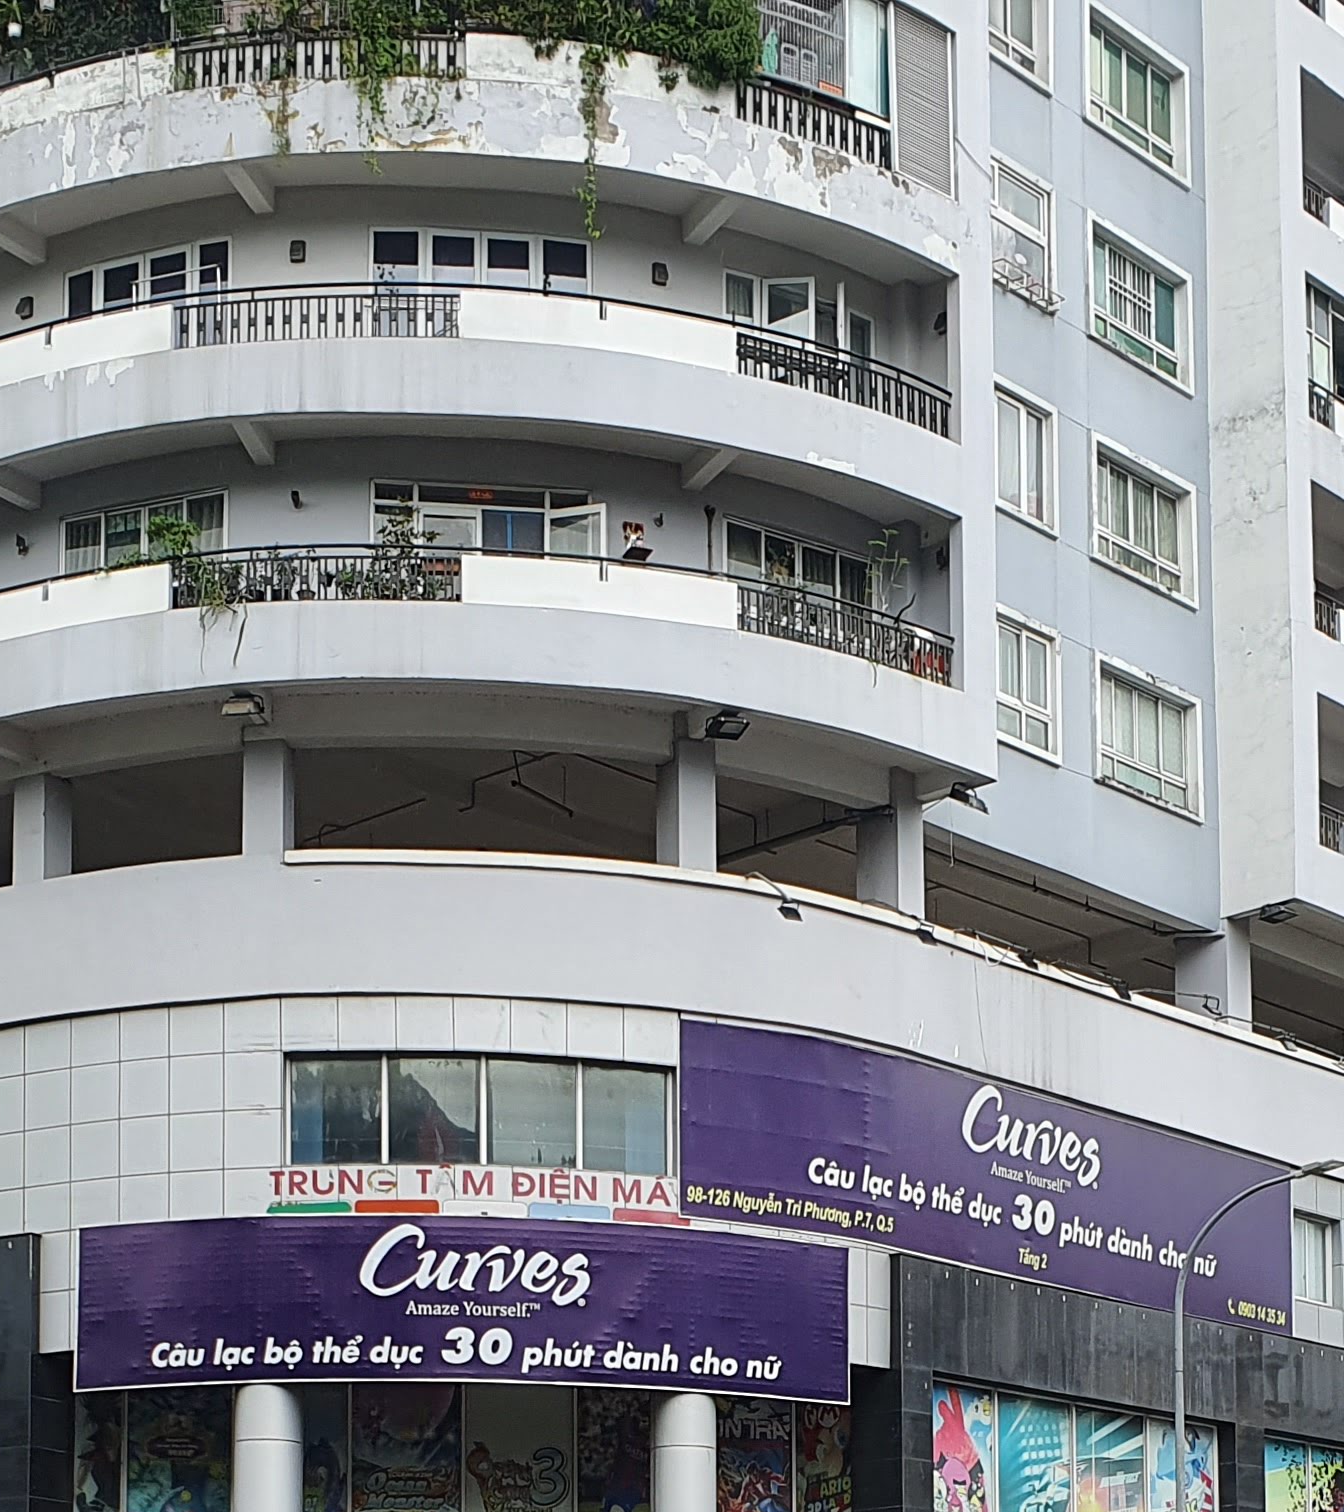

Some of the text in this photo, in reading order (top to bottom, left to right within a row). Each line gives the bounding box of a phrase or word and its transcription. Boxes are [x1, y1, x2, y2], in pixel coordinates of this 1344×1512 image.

[961, 1084, 1102, 1189] Curves
[269, 1163, 679, 1208] TRUNG TÂM ĐIỆN MÁ
[990, 1162, 1025, 1183] Amaze
[686, 1185, 730, 1208] 98-126
[733, 1189, 783, 1216] Nguyễn
[803, 1201, 853, 1227] Phương,
[854, 1210, 874, 1232] P.7,
[875, 1214, 895, 1234] Q.5
[807, 1157, 856, 1190] Câu
[862, 1164, 893, 1201] lạc
[899, 1173, 926, 1212] bộ
[931, 1182, 965, 1216] thể
[968, 1195, 1002, 1231] dục
[1012, 1195, 1055, 1236] 30
[1058, 1222, 1104, 1249] phút
[1106, 1229, 1153, 1263] dành
[1193, 1253, 1218, 1278] nữ
[358, 1222, 592, 1308] Curves
[1041, 1257, 1048, 1269] 2
[405, 1300, 459, 1316] Amaze
[1257, 1305, 1266, 1321] 14
[151, 1326, 783, 1381] Câu lạc bộ thể dục 30 phút dành cho nữ
